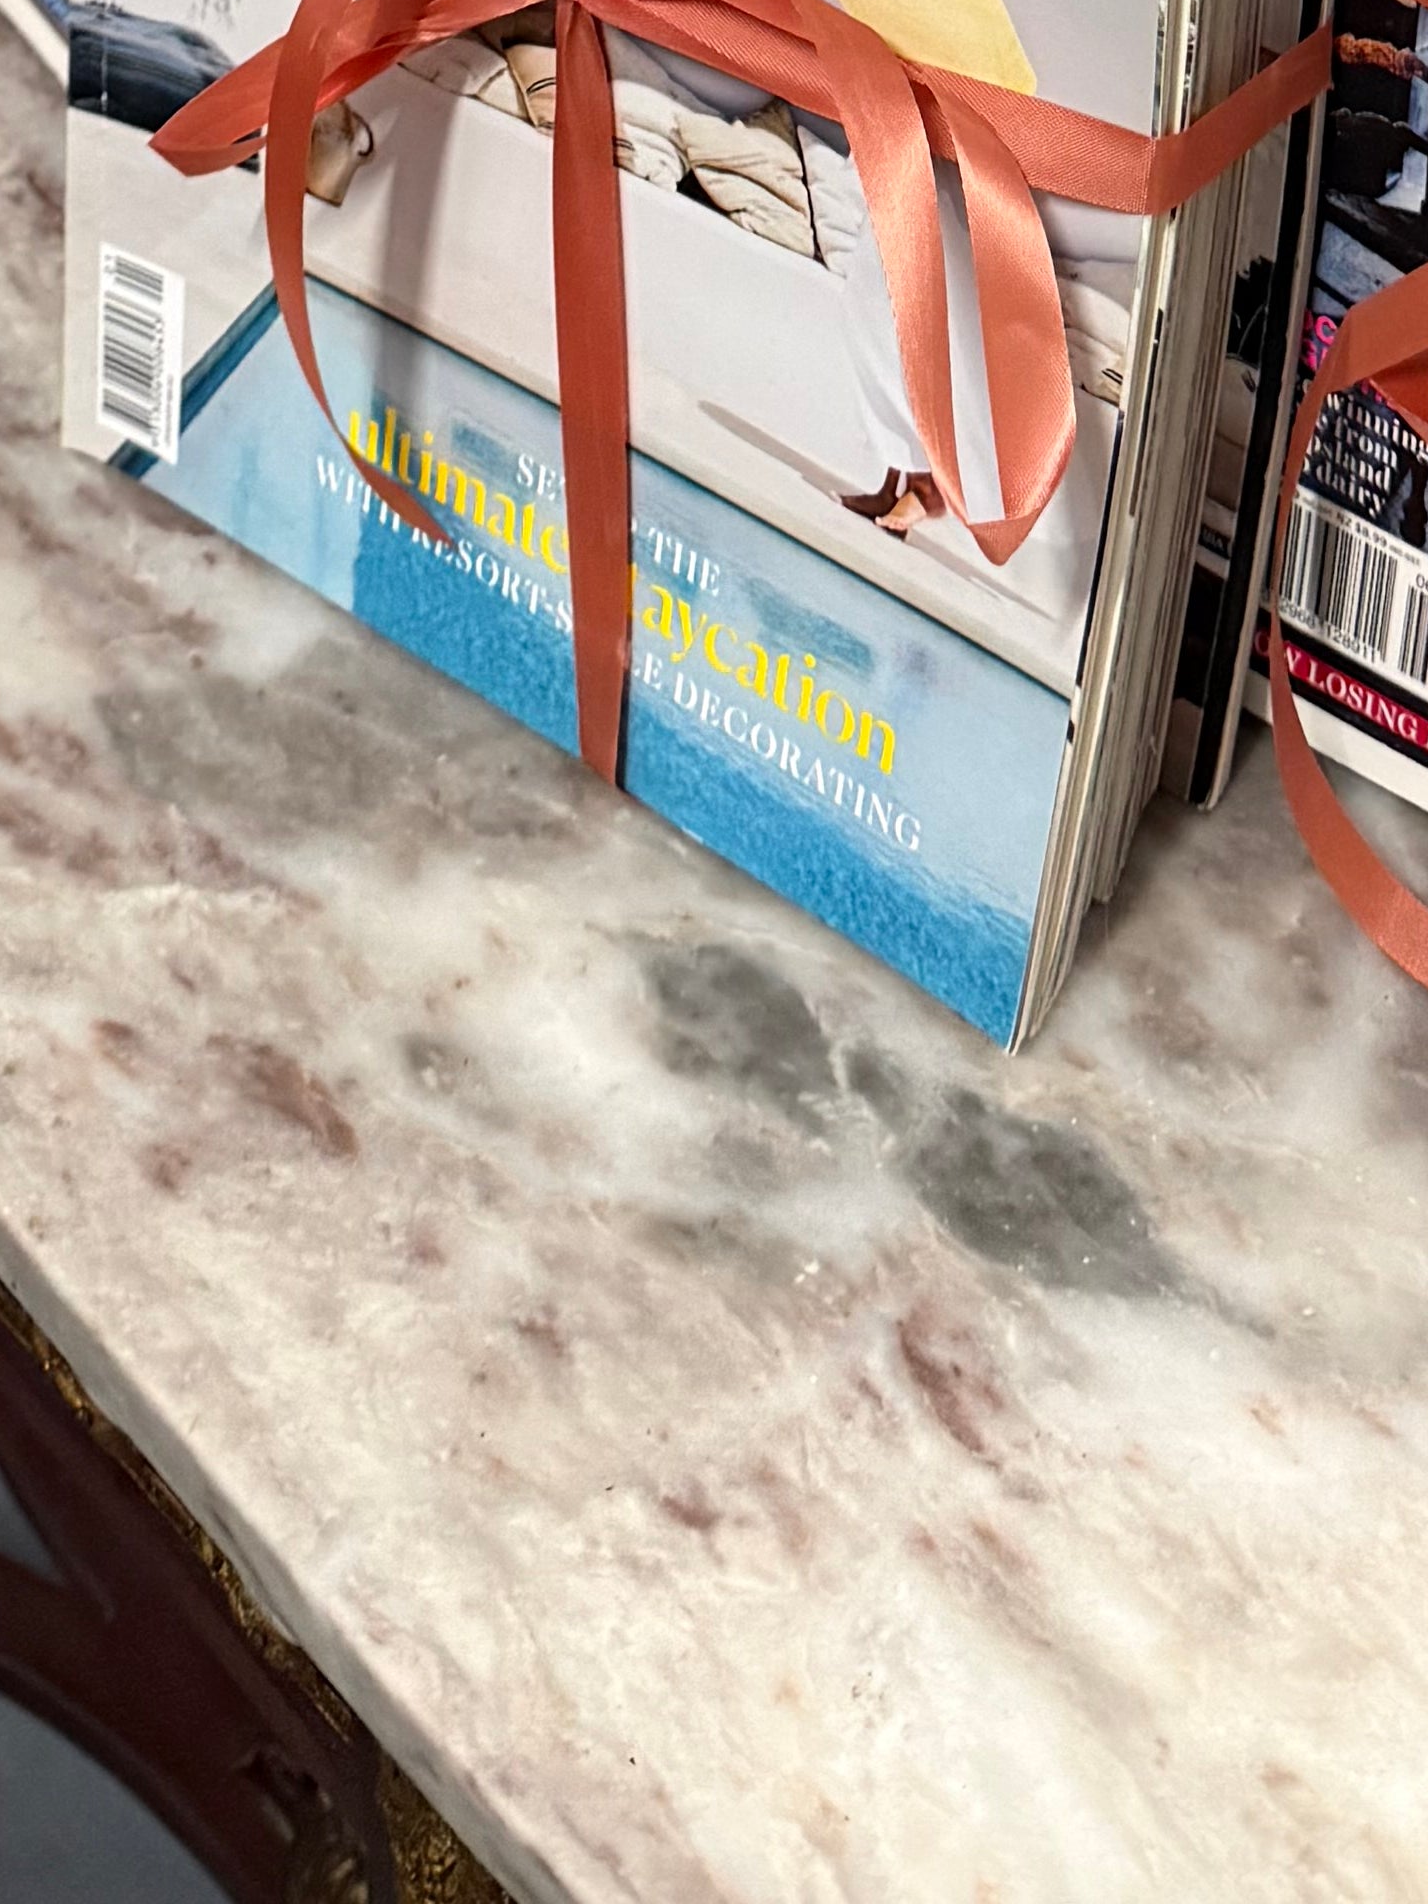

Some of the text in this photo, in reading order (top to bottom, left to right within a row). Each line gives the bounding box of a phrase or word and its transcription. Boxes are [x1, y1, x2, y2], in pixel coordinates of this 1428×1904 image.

[348, 406, 570, 575] ultimate
[647, 526, 721, 596] THE
[628, 561, 899, 776] aycation
[1306, 658, 1419, 742] LOSING
[674, 672, 922, 852] DECORATING
